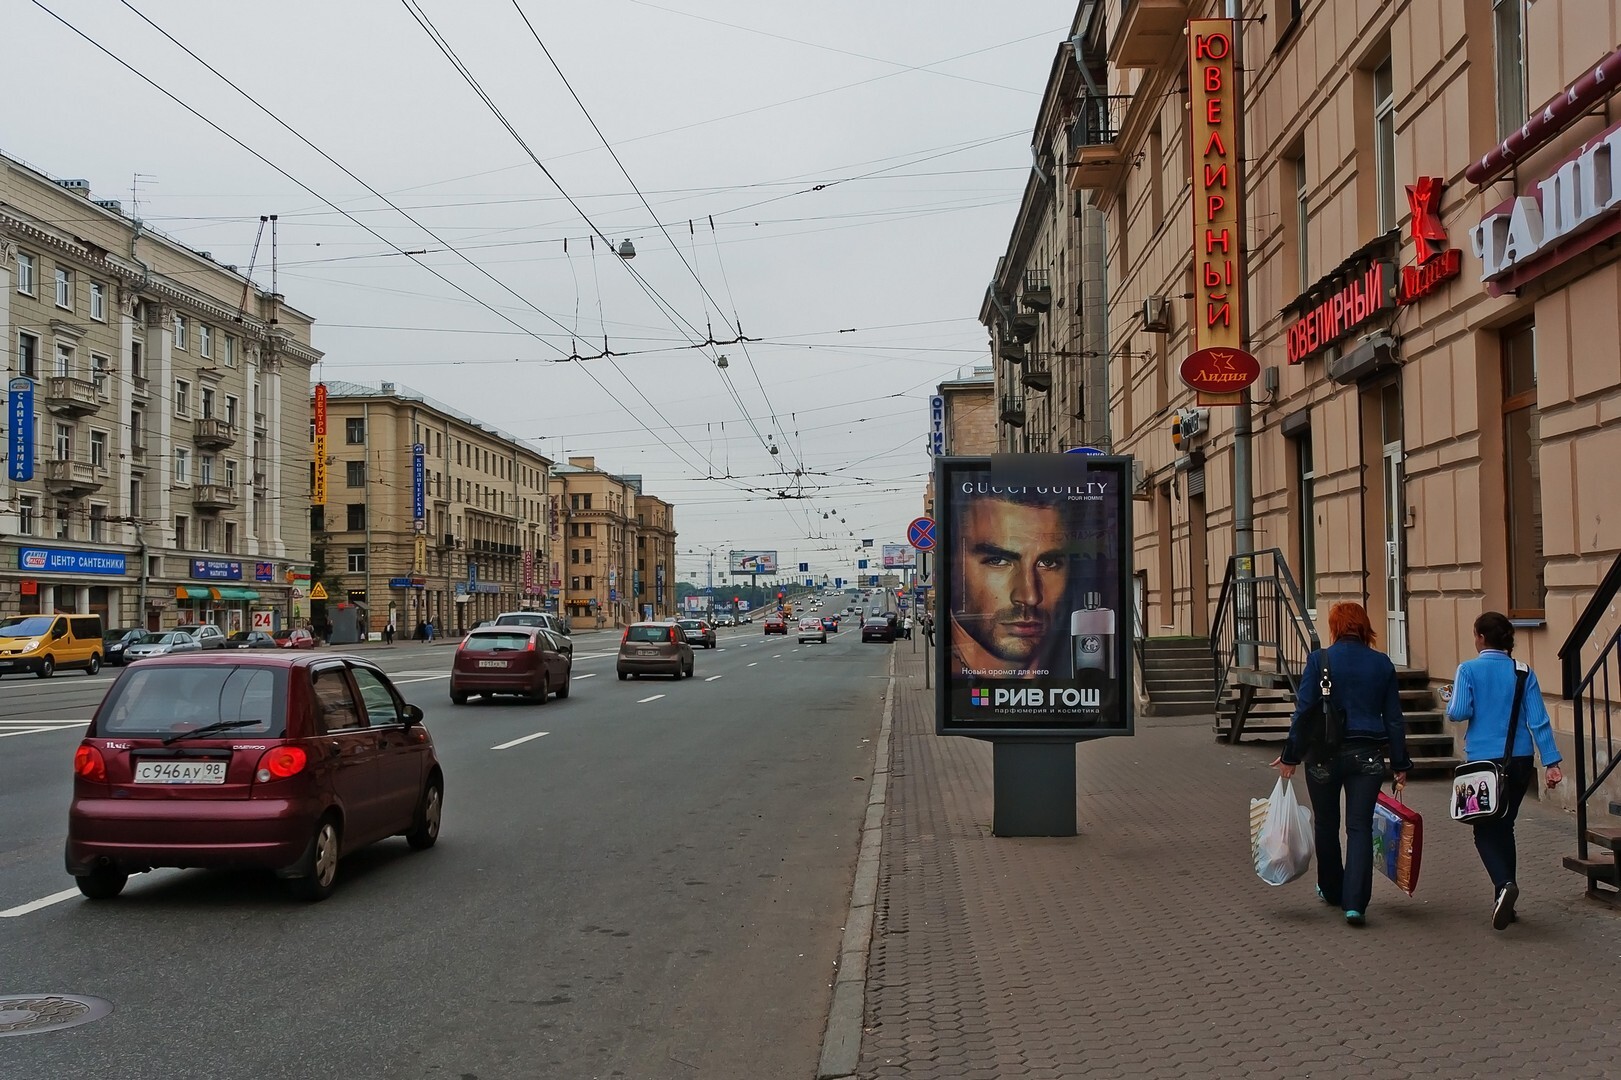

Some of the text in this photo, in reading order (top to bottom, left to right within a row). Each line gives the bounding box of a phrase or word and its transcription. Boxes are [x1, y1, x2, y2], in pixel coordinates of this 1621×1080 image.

[1195, 31, 1232, 329] ЮВЕЛИРНЫЙ
[1468, 126, 1621, 283] ЧАШ
[1286, 258, 1384, 366] ЮВЕЛИРНЫЙ
[1192, 368, 1248, 384] Лидия
[16, 392, 25, 479] САНТЕХНИКА
[51, 555, 124, 569] ЦЕНТР САНТЕХНИКИ
[256, 564, 272, 576] 24
[254, 613, 271, 627] 24
[961, 667, 987, 675] Новый
[994, 688, 1100, 706] РИВ ГОШ
[205, 764, 220, 775] 98
